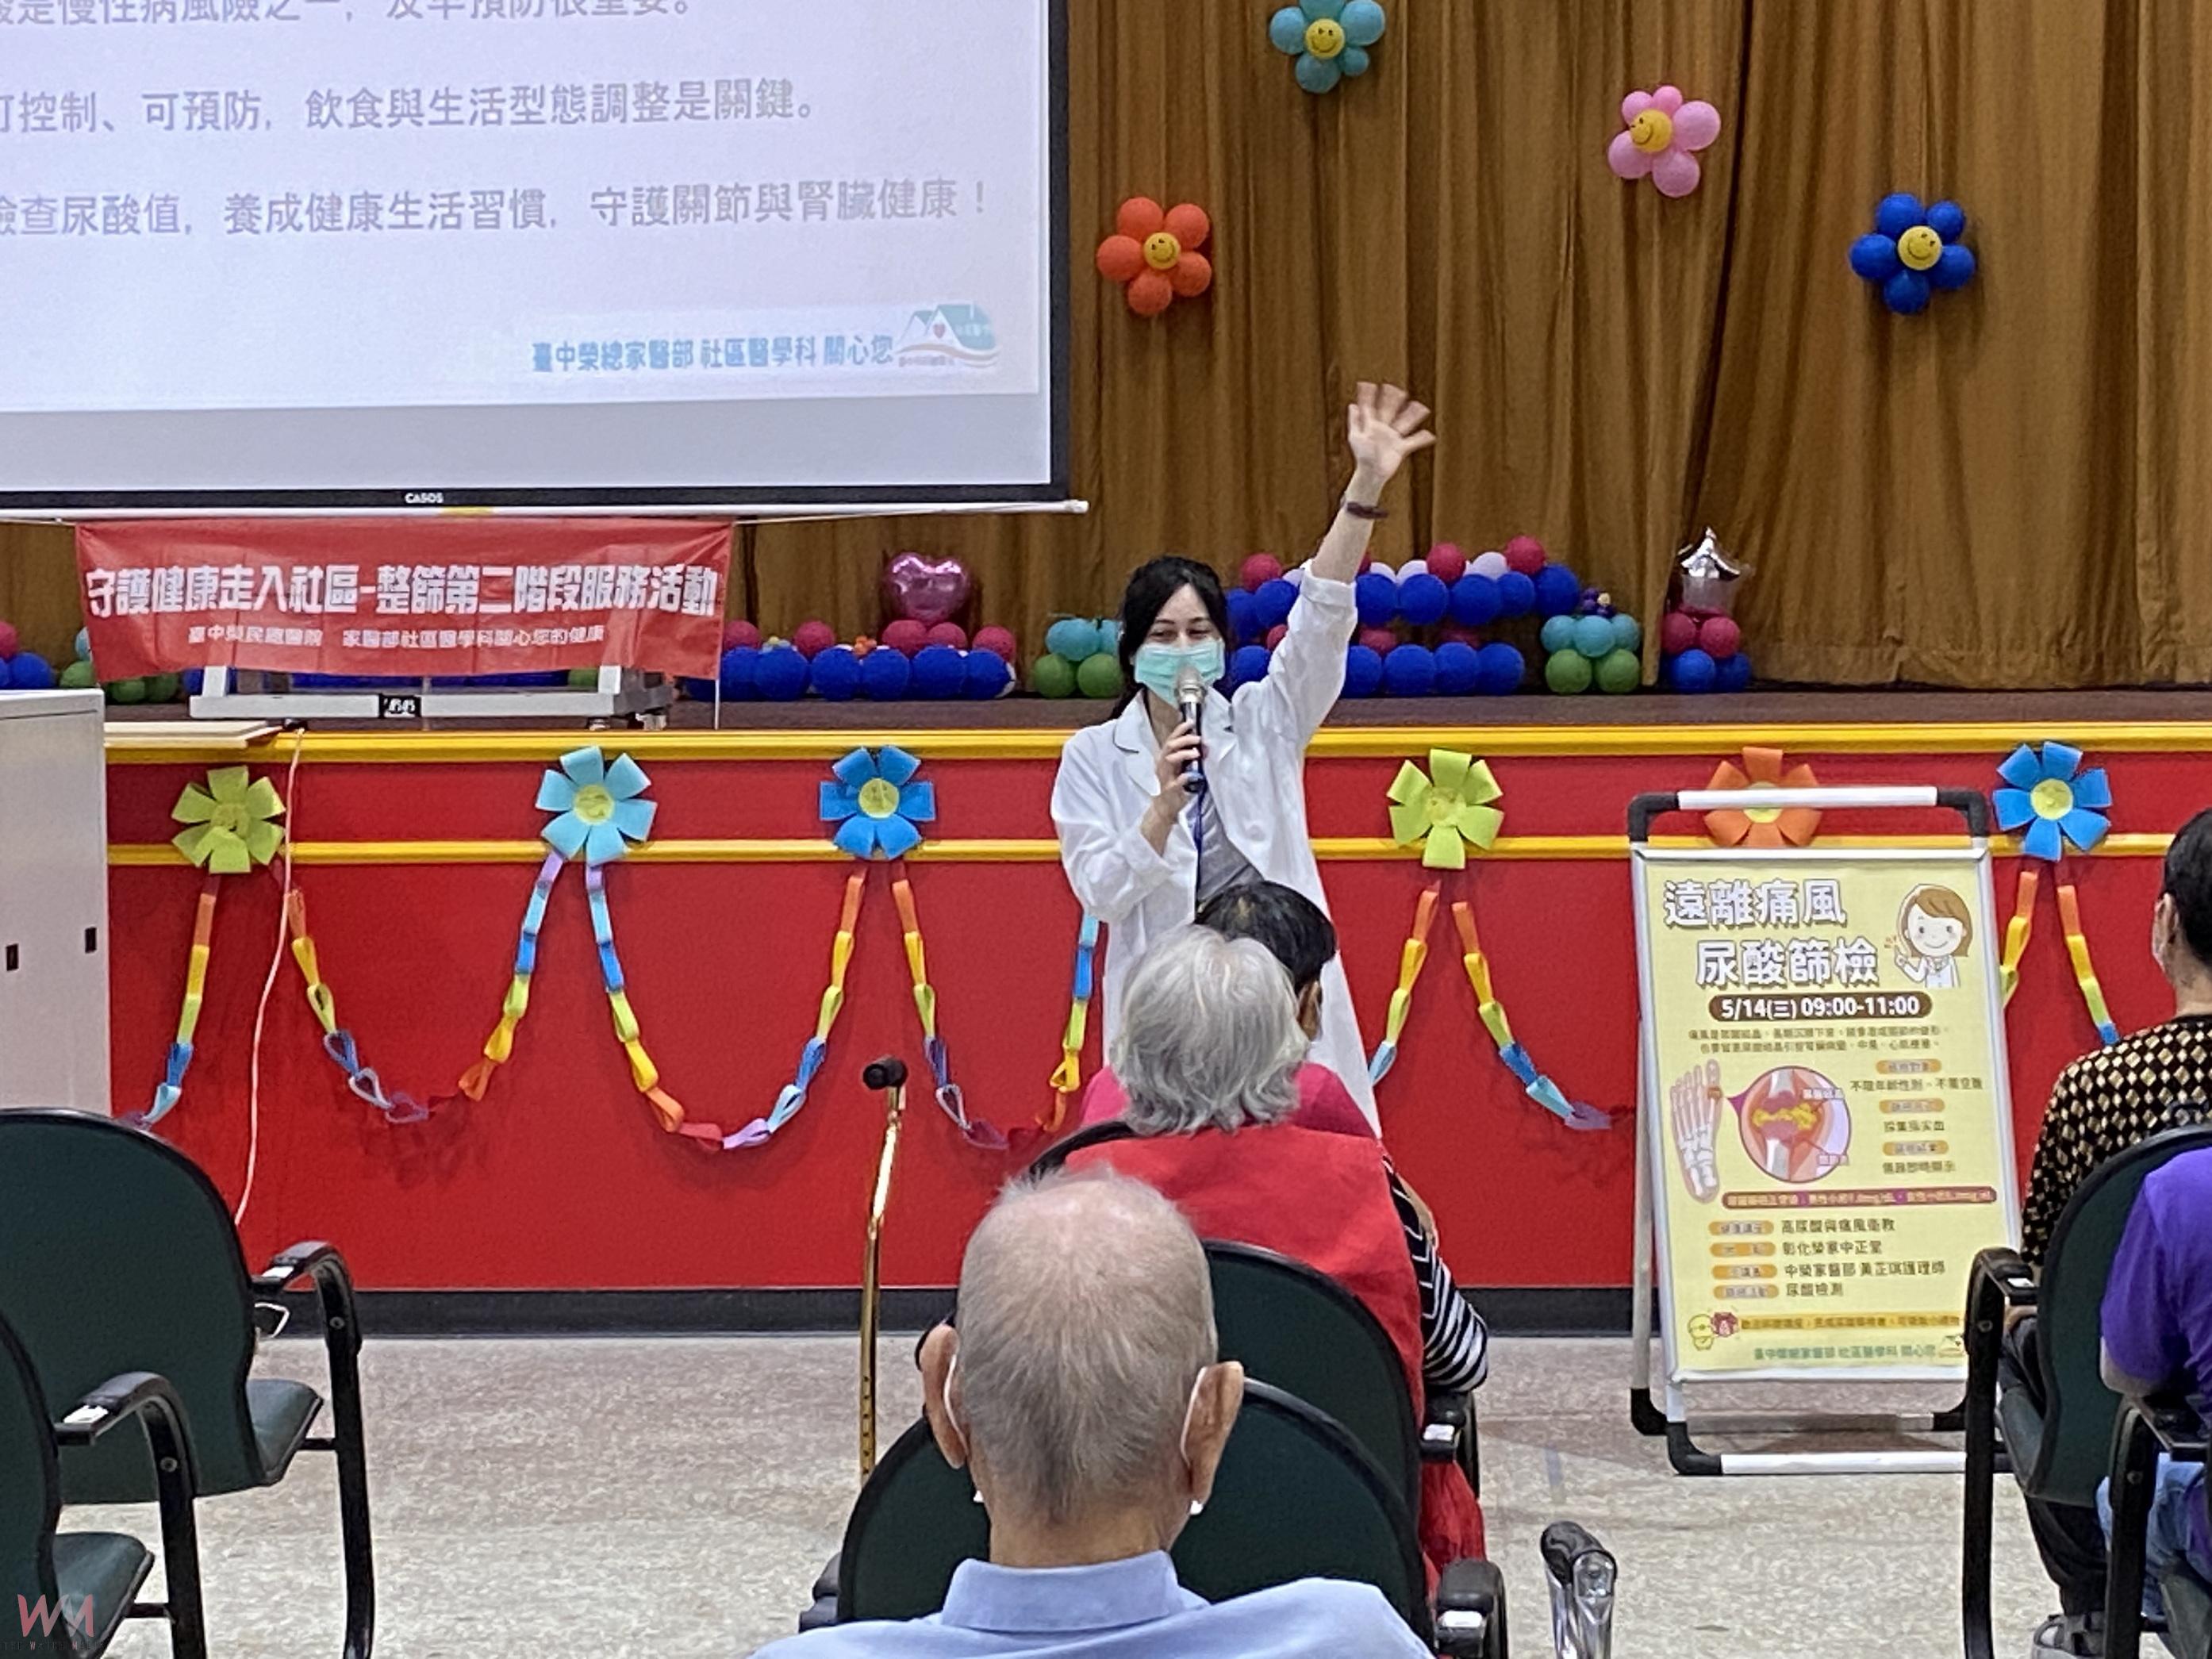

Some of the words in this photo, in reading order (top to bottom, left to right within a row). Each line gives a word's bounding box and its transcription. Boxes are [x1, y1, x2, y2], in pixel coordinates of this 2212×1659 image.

[405, 493, 444, 503] CASOS
[86, 563, 718, 617] 守護健康走入社區-整篩第二階段服務活動
[1663, 878, 1847, 928] 遠離痛風
[1695, 936, 1879, 990] 尿酸篩檢
[1721, 998, 1796, 1020] 5/14(三)
[1800, 996, 1919, 1016] 09:00-11:00
